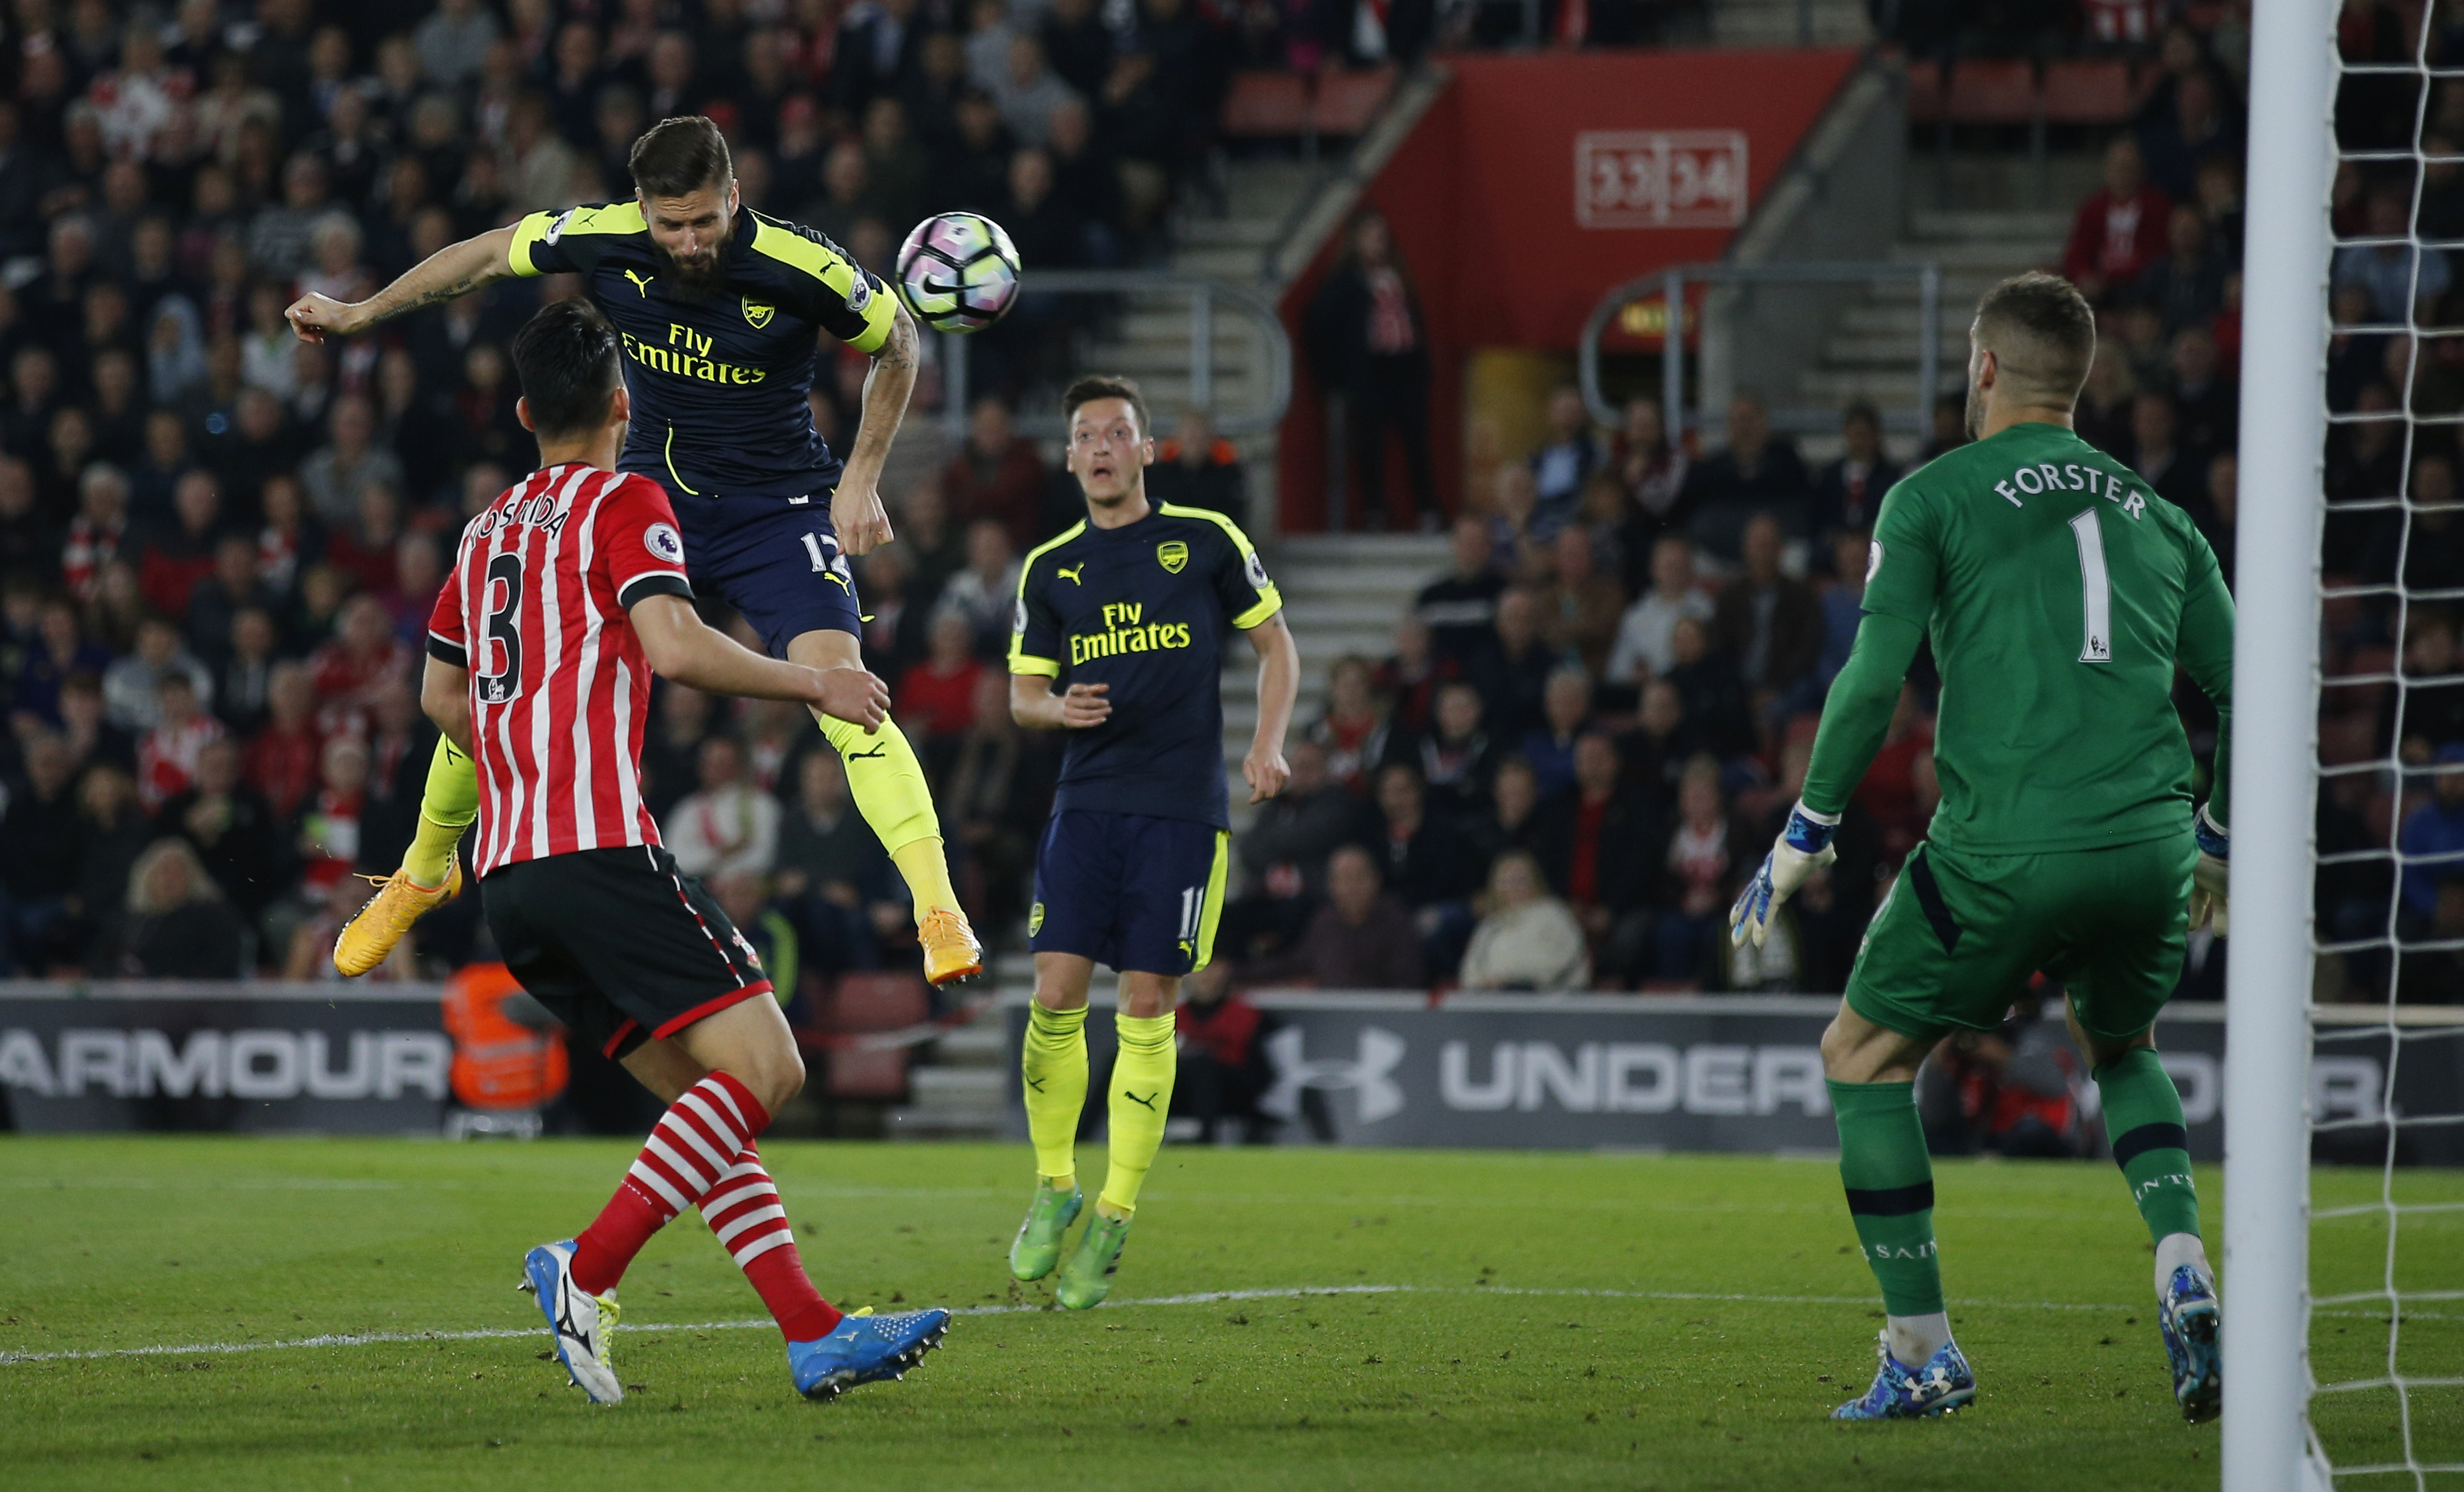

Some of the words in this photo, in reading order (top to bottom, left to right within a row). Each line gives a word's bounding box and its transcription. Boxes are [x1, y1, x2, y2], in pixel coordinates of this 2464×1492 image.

[622, 332, 766, 385] Emirates
[669, 323, 713, 358] Fly
[1994, 464, 2146, 521] FORSTER
[801, 532, 852, 582] 12
[2069, 507, 2112, 662] 1
[476, 551, 523, 704] 3
[1101, 602, 1143, 627] Fly
[1069, 621, 1191, 666] Emirates
[1178, 886, 1204, 939] 11
[0, 1028, 450, 1099] ARMOUR
[1439, 1041, 1832, 1116] UNDER
